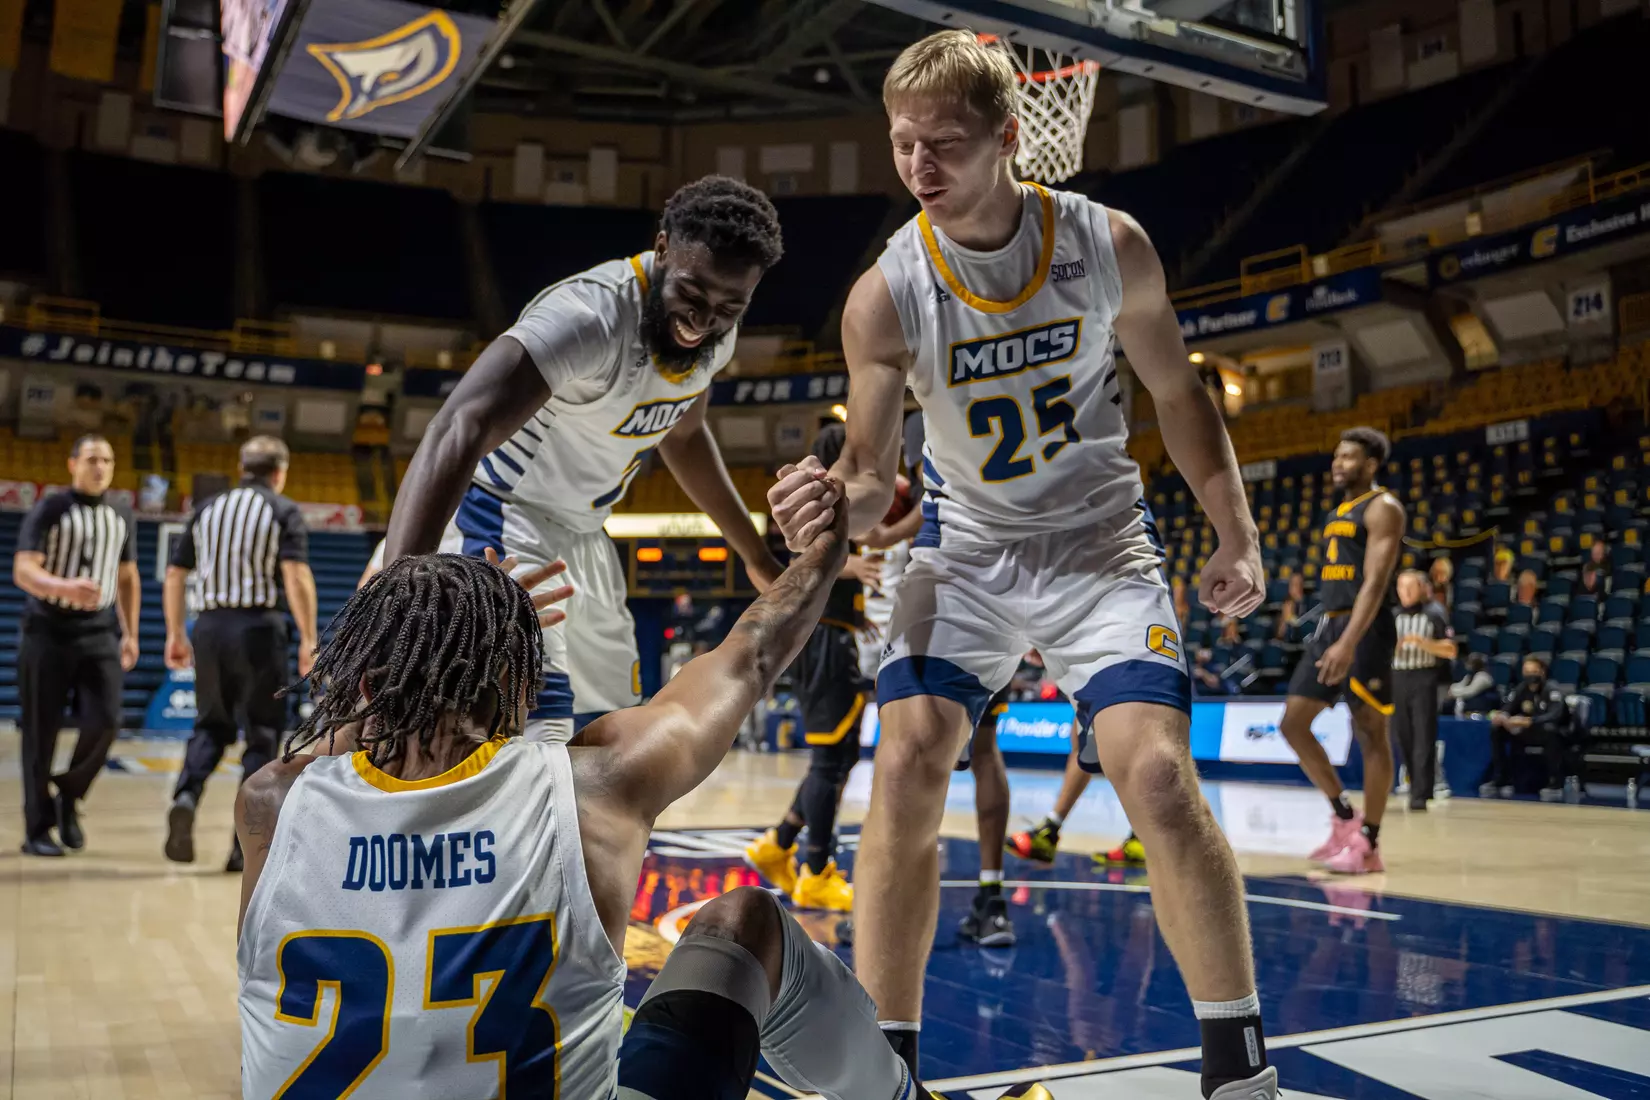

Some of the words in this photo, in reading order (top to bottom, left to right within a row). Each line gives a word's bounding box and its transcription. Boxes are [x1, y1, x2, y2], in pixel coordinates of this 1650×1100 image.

[1051, 258, 1086, 282] SOCON
[954, 323, 1076, 380] MOCS
[619, 396, 698, 434] MOC
[966, 375, 1083, 484] 25
[1003, 716, 1059, 739] Provider
[341, 829, 497, 893] DOOMES
[274, 911, 562, 1100] 23
